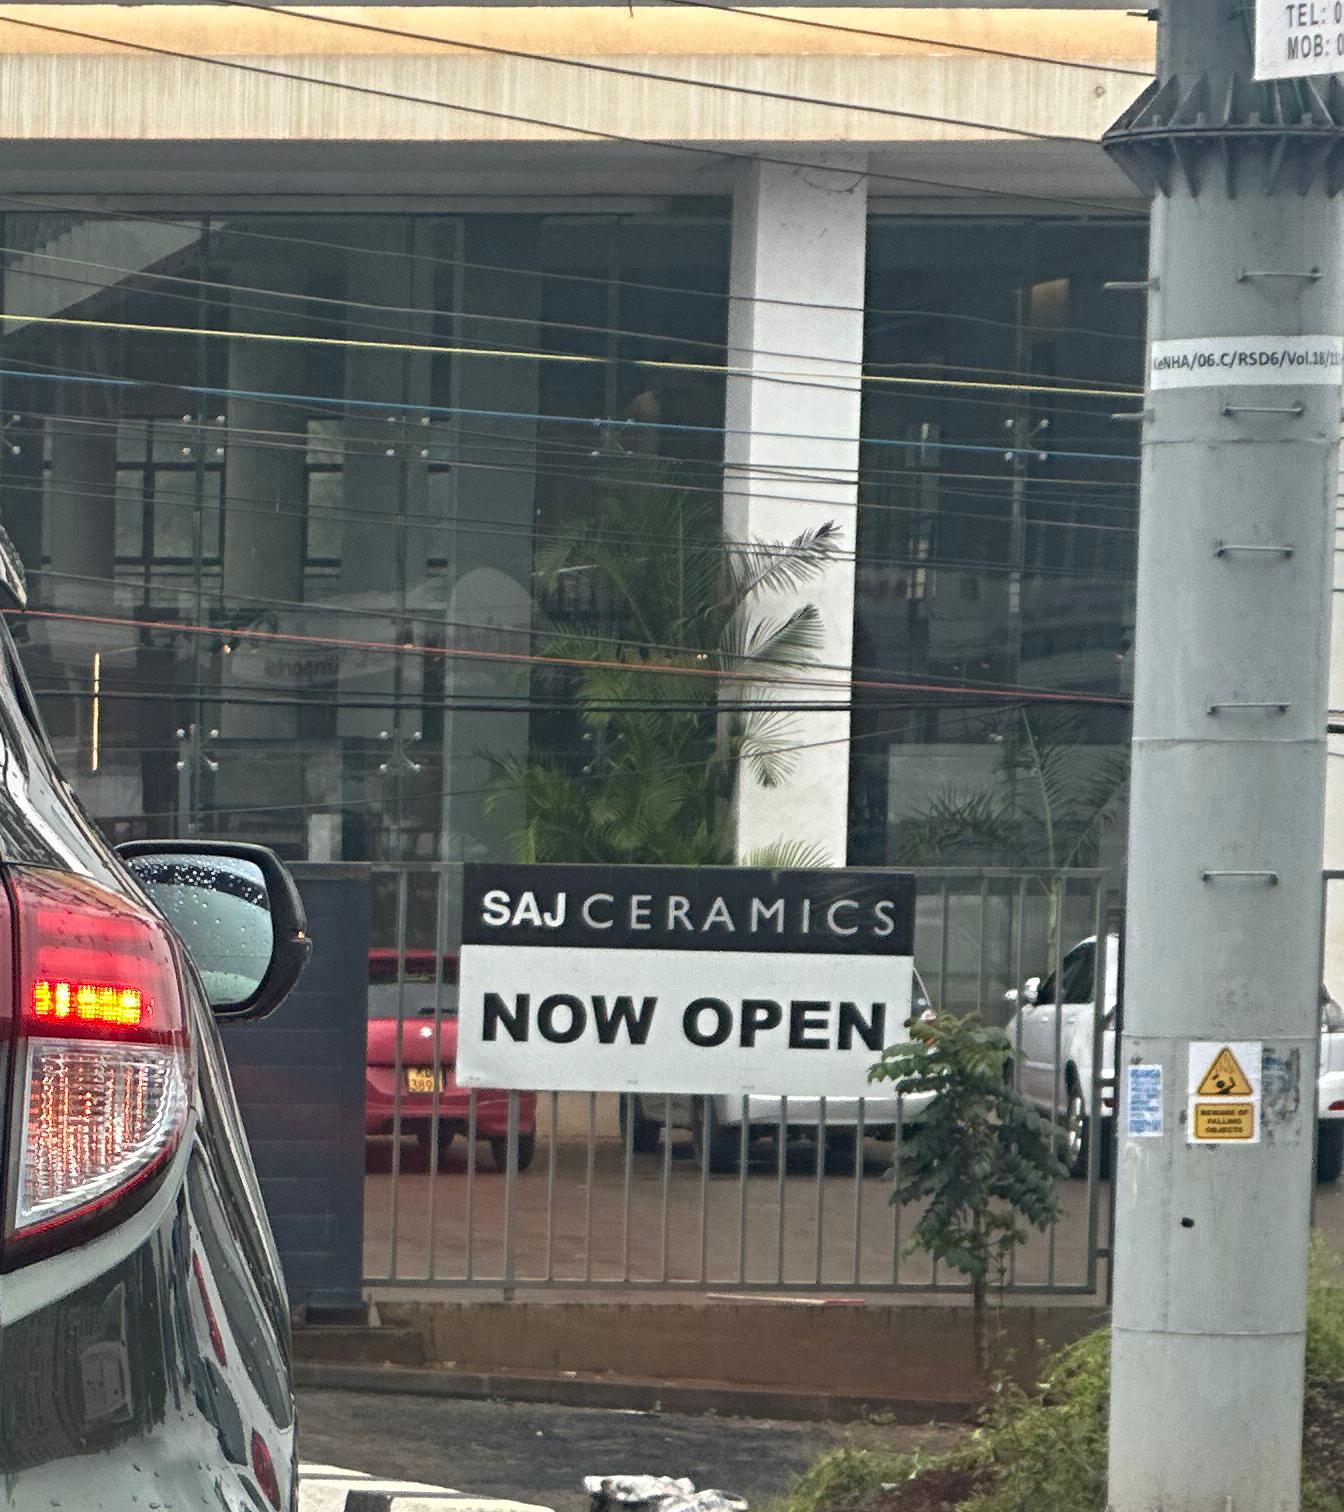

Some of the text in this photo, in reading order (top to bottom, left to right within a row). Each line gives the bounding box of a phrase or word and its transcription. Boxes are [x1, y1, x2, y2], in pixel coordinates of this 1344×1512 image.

[1286, 3, 1327, 28] TEL:
[1287, 34, 1330, 60] MOB:
[482, 890, 895, 937] SAJ CERAMICS
[481, 992, 887, 1052] NOW OPEN
